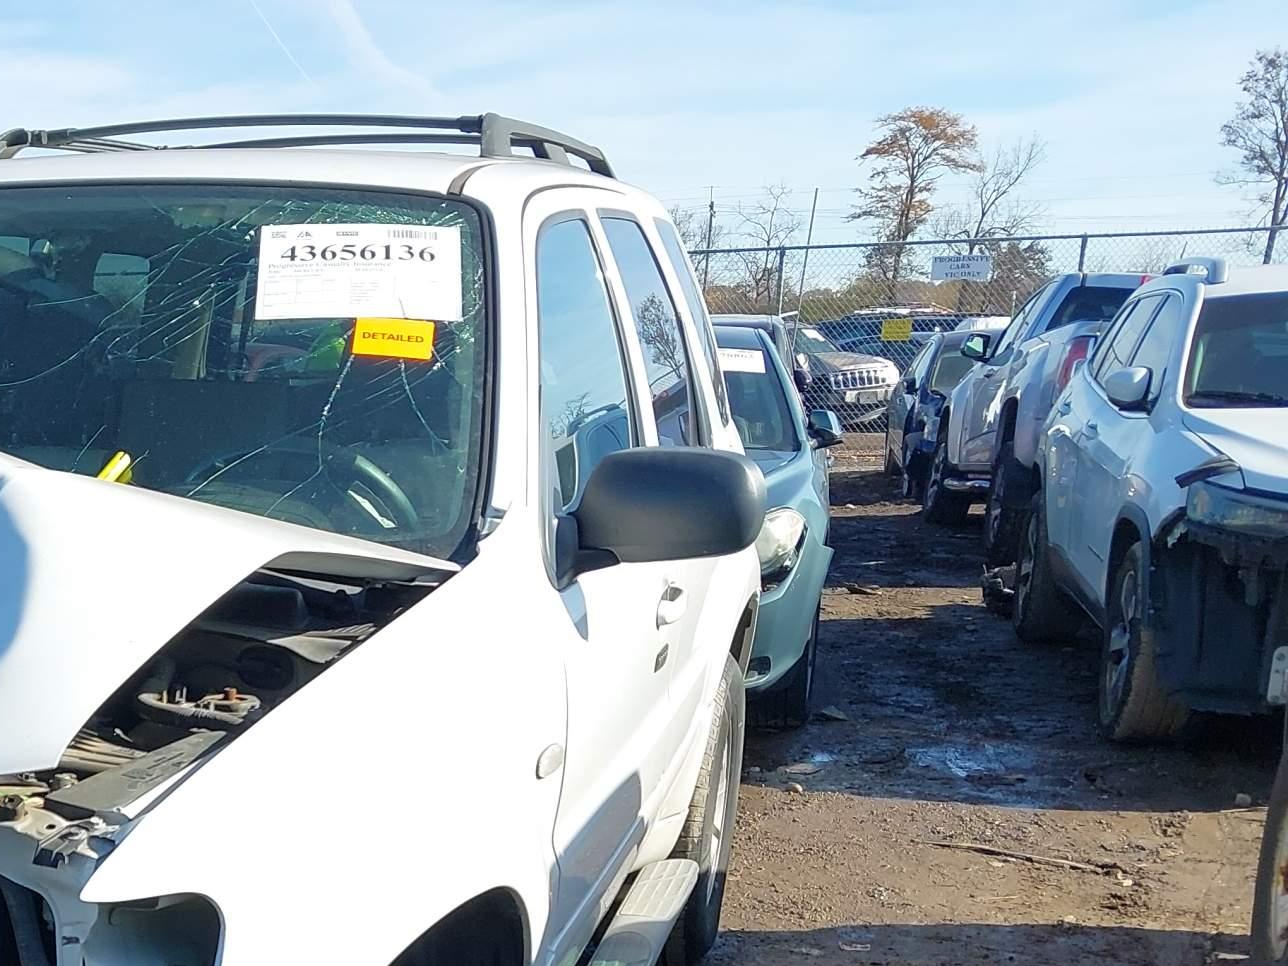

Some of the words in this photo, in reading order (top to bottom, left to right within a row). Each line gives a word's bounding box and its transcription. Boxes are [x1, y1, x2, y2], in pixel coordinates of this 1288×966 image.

[280, 243, 436, 262] 43656136
[934, 255, 990, 263] PROGRESSIVE
[362, 331, 424, 344] DETAILED
